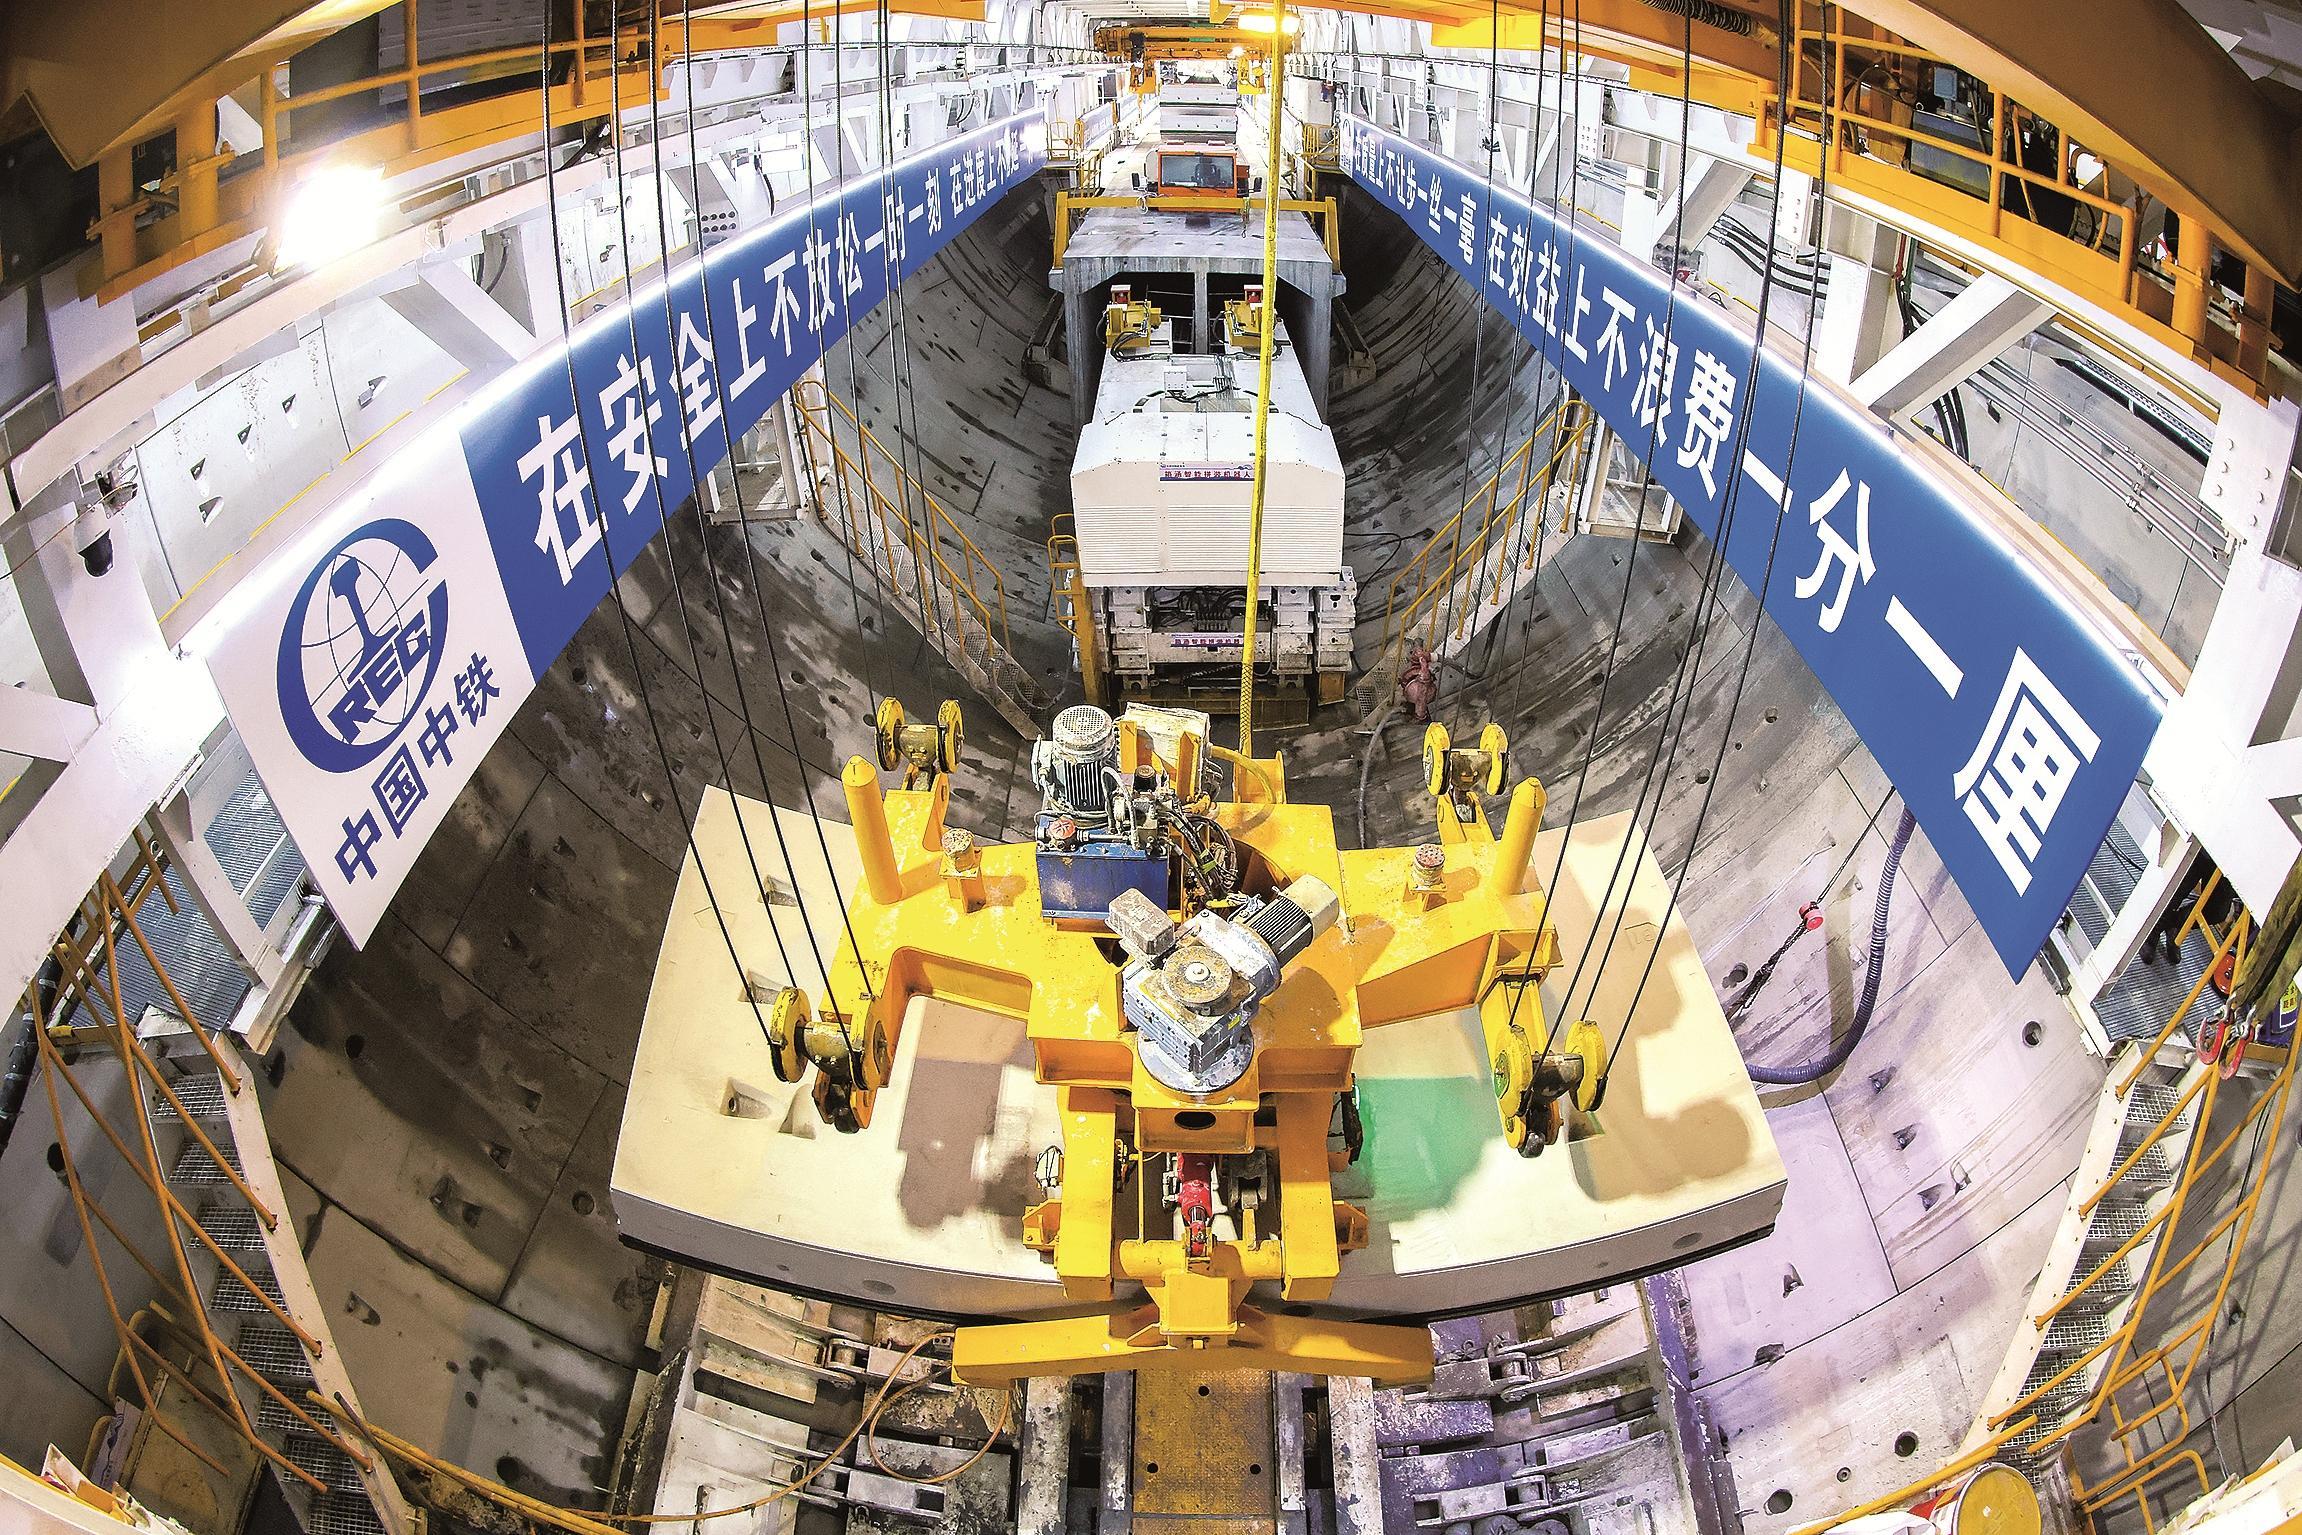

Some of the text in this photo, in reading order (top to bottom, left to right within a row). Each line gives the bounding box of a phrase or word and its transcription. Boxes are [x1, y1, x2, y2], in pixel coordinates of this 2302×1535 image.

[516, 167, 942, 587] 在安全上不放松一时一刻
[1355, 130, 2102, 898] 在质量上不让步一丝一毫 在效益上不浪费一分一厘
[333, 652, 501, 885] 中国中铁
